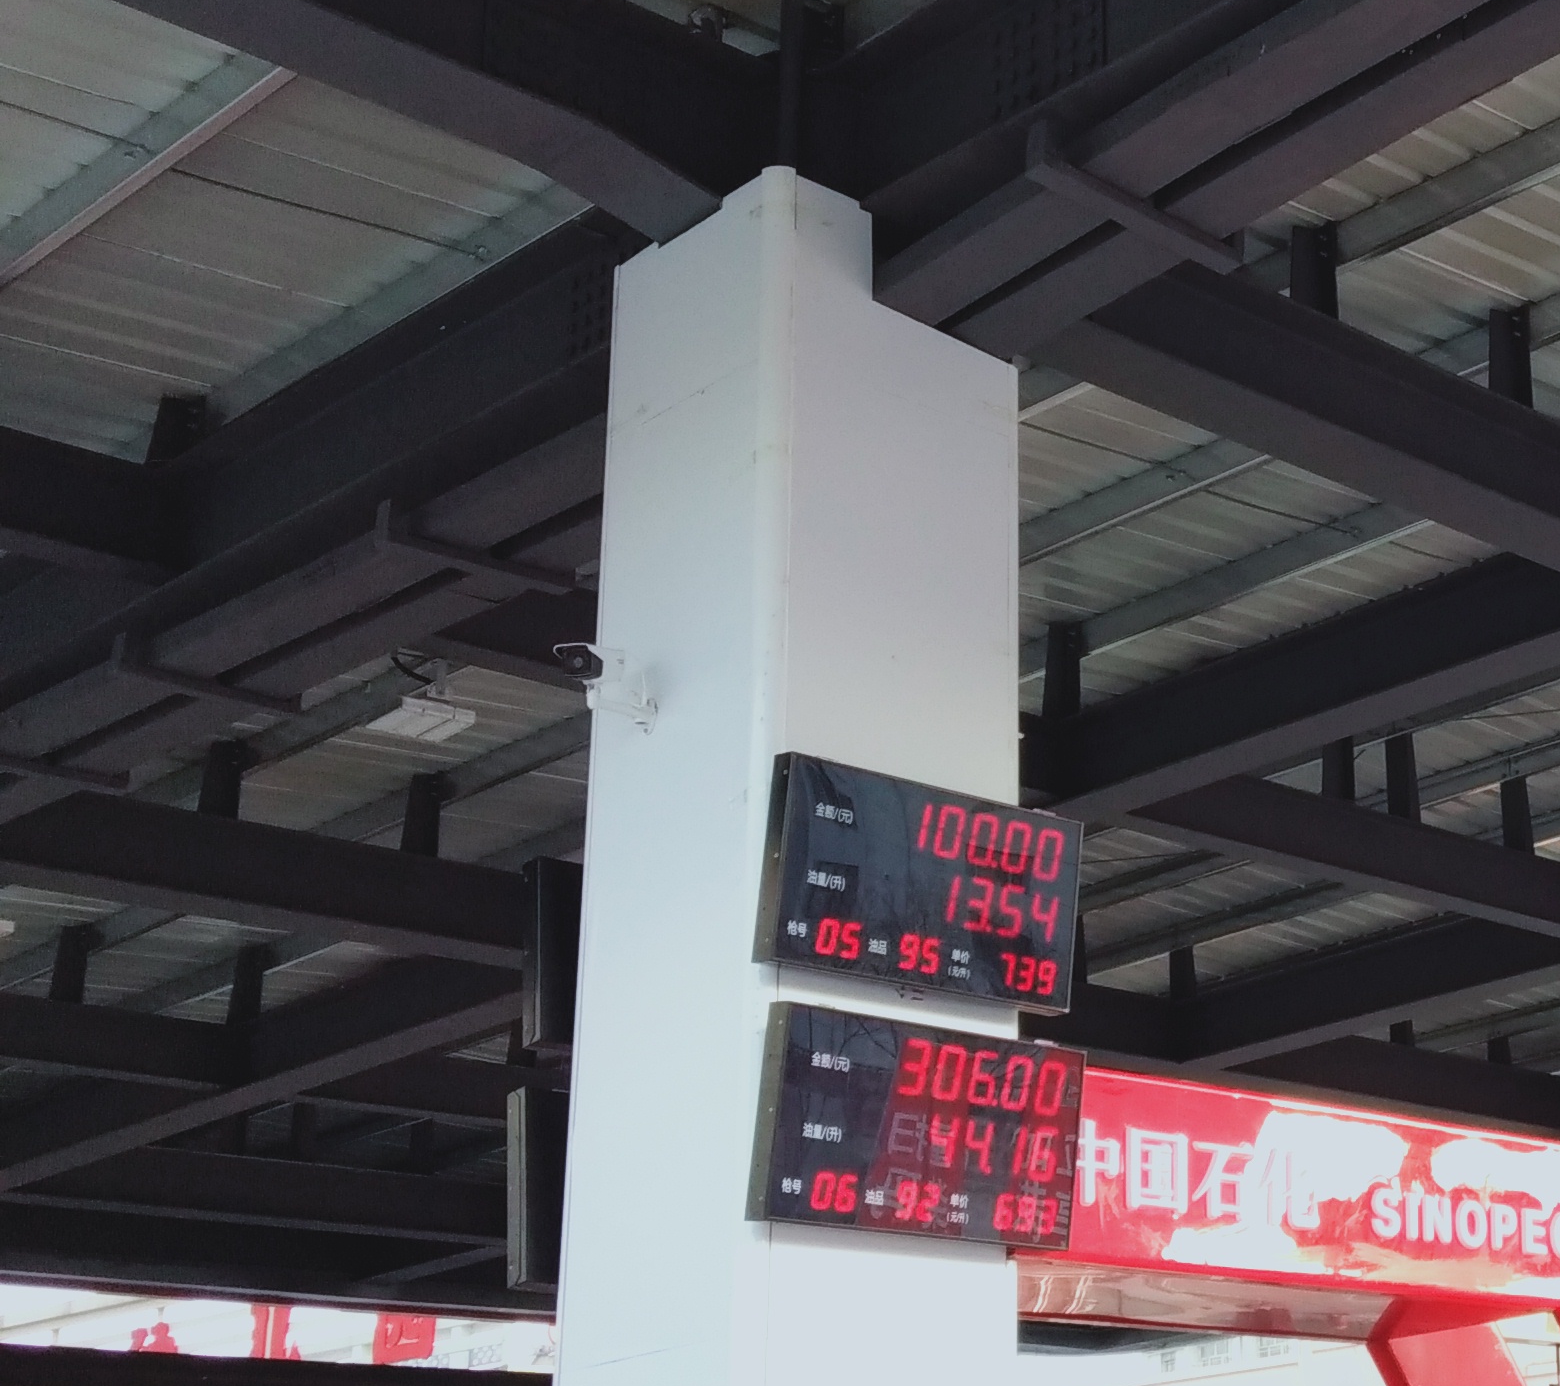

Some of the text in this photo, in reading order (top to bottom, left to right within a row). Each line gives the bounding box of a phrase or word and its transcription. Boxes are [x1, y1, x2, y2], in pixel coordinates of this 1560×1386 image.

[815, 918, 863, 960] 05
[898, 933, 941, 975] 95
[810, 1171, 859, 1213] 06
[895, 1180, 941, 1222] 92
